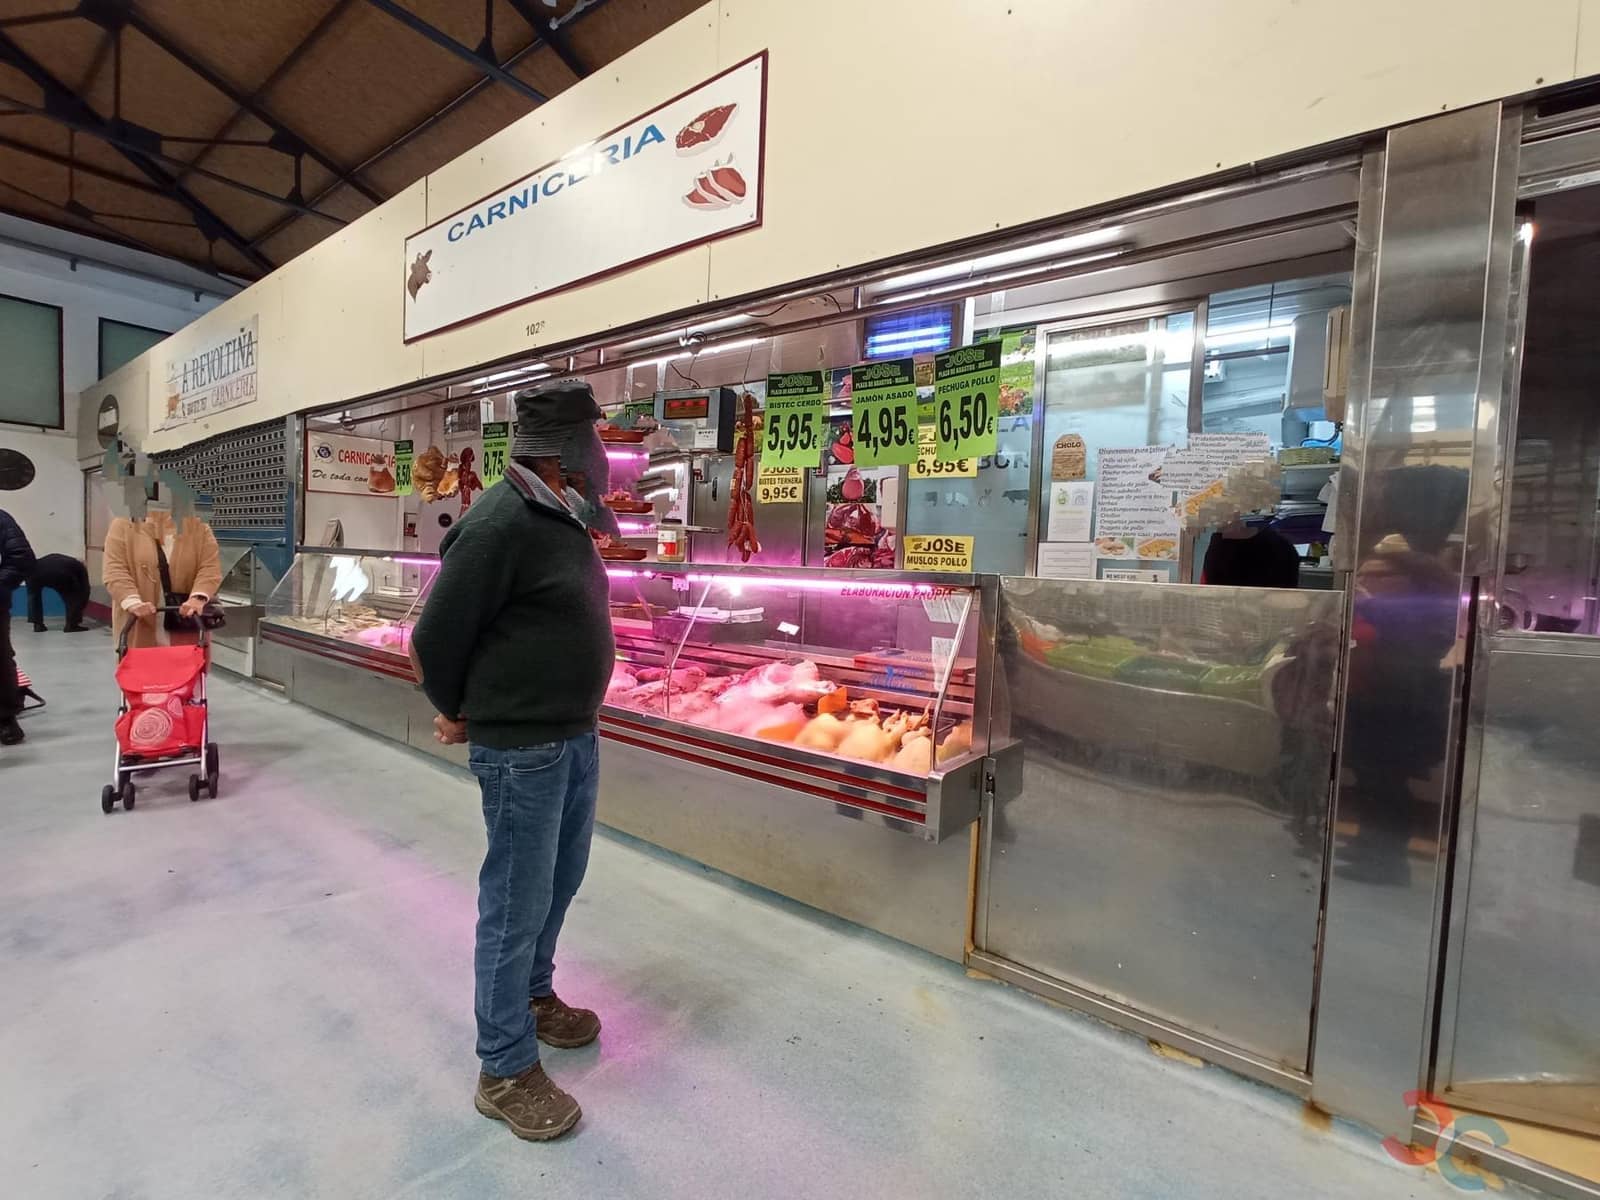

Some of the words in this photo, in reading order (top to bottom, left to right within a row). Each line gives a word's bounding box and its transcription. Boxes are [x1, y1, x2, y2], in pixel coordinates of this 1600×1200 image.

[971, 375, 996, 388] POLLO
[856, 393, 884, 404] JAMÓN
[885, 390, 914, 401] ASADO
[939, 392, 994, 451] 6,50€
[767, 413, 818, 459] 5,95€
[857, 405, 915, 457] 4,95€
[762, 486, 797, 500] 9,95€
[923, 538, 965, 553] JOSE
[906, 555, 938, 565] MUSLOS
[940, 557, 968, 567] POLLO
